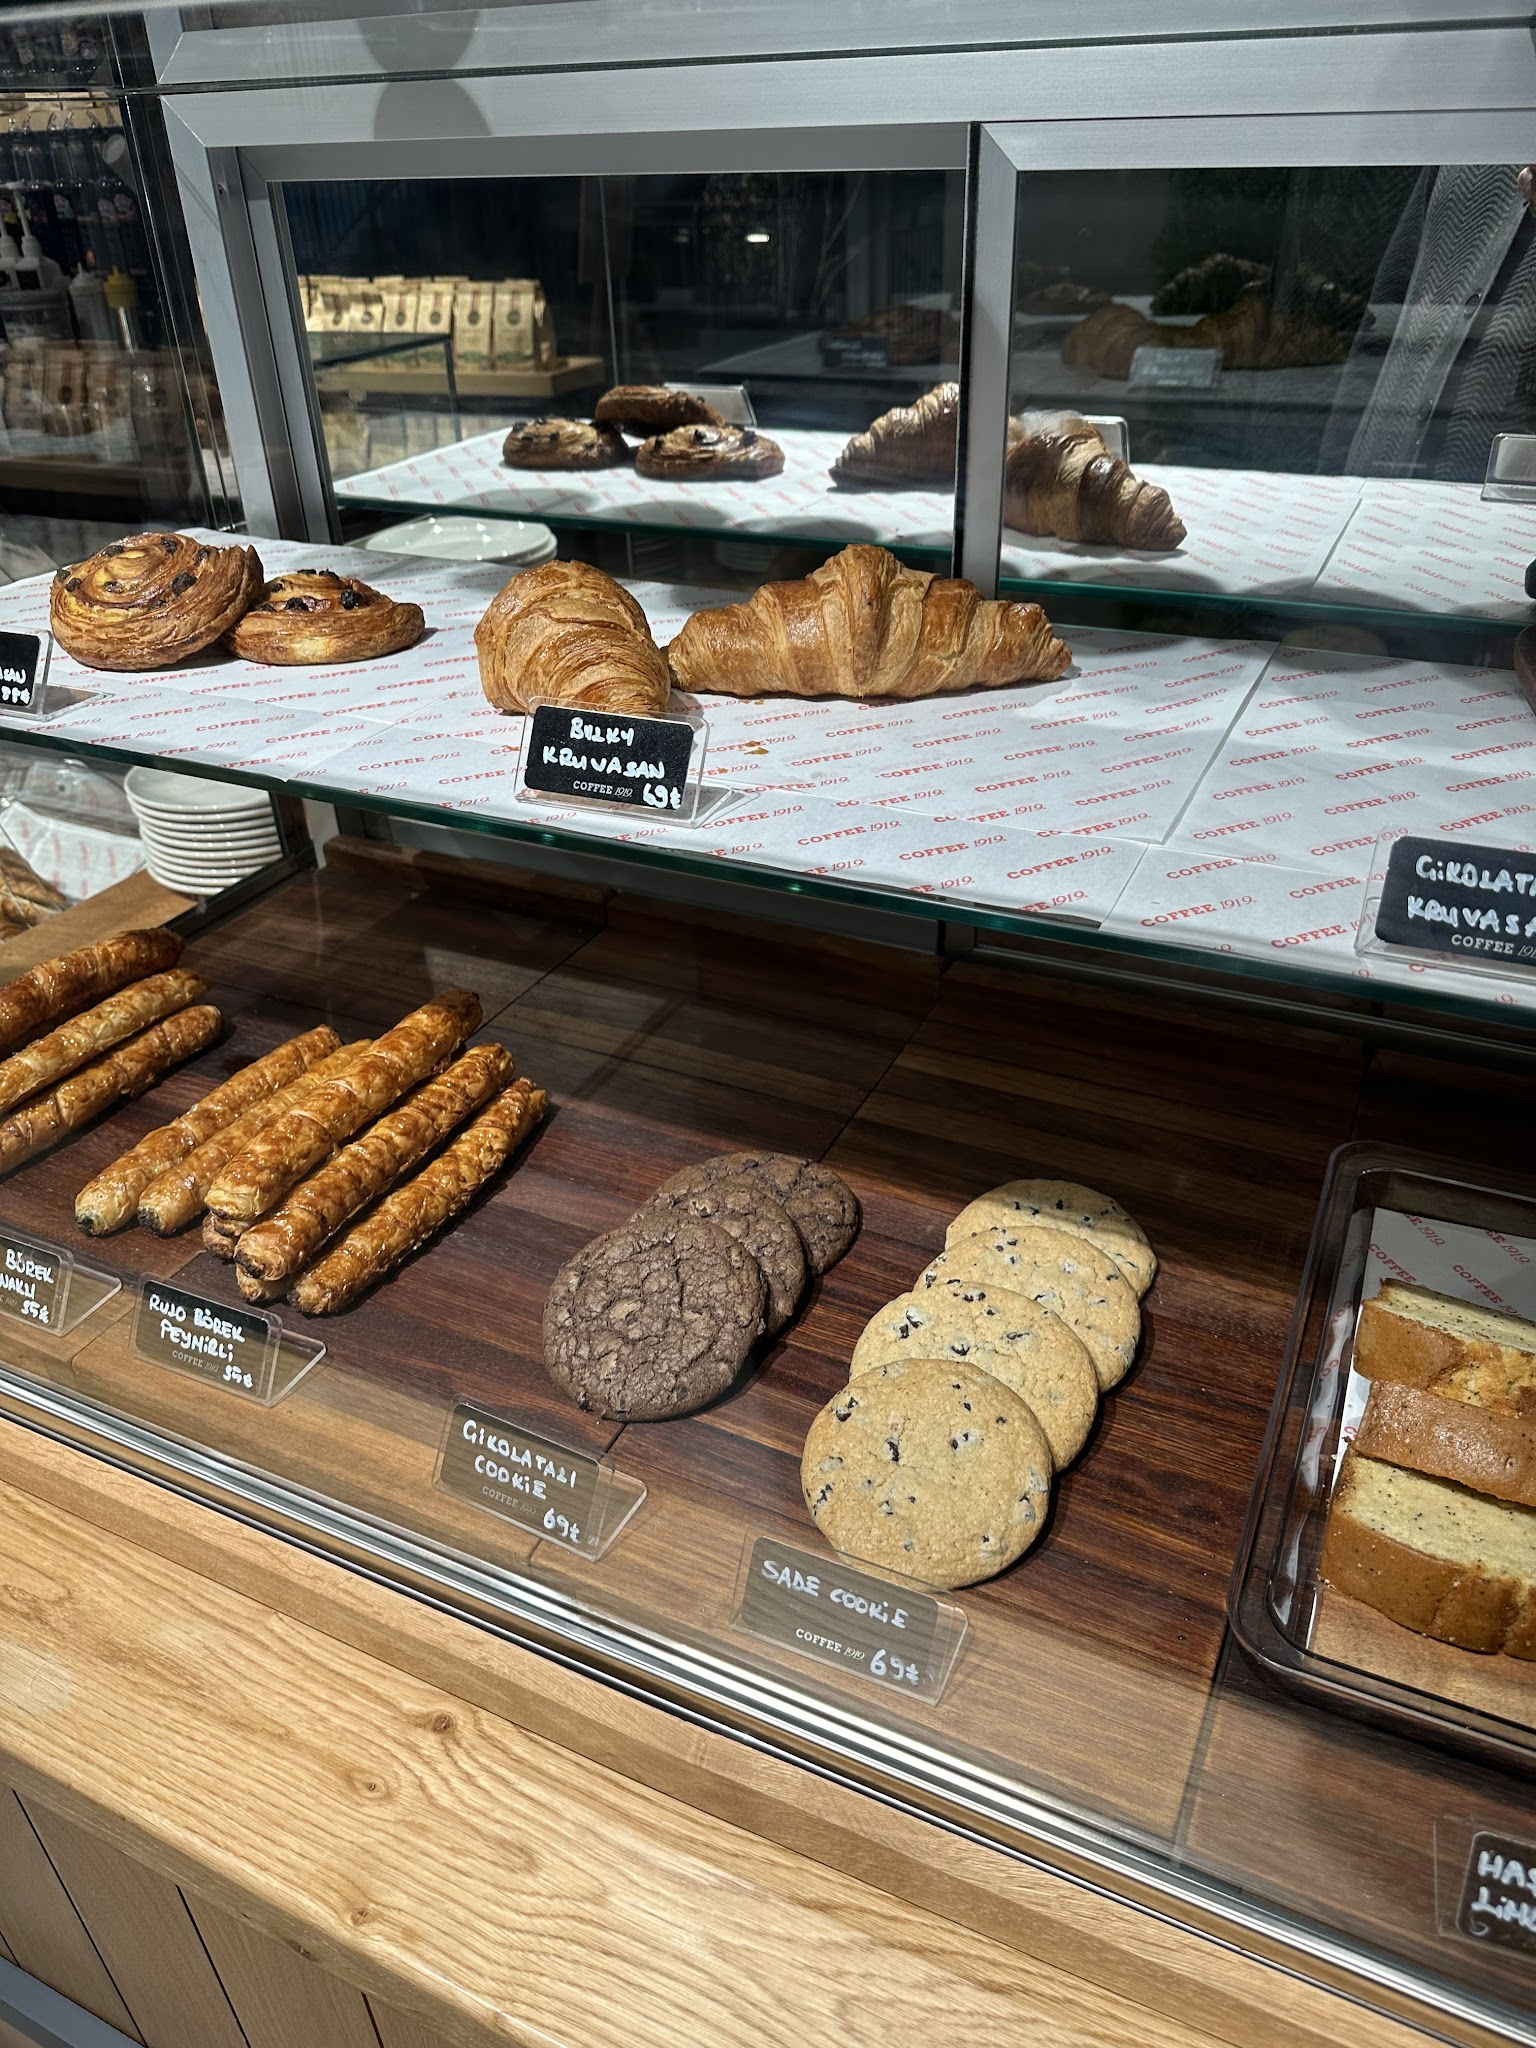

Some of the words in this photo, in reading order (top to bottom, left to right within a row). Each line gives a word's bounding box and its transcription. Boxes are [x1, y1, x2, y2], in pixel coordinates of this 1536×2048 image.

[1182, 647, 1233, 663] COFFEE
[1079, 665, 1130, 679] COFFEE
[1164, 671, 1218, 688] COFFEE
[1271, 670, 1323, 682] COFFEE
[376, 677, 435, 691] COFFEE
[1363, 680, 1416, 693] COFFEE
[254, 692, 317, 705] COFFEE
[1055, 689, 1111, 704] COFFEE
[1259, 695, 1313, 709] COFFEE
[1459, 690, 1512, 704] COFFEE
[322, 702, 386, 717] COFFEE
[942, 706, 999, 720] COFFEE
[1145, 697, 1201, 714] COFFEE
[1355, 705, 1409, 719] COFFEE
[129, 707, 194, 721] COFFEE
[743, 713, 801, 727] COFFEE
[196, 718, 260, 732] COFFEE
[825, 723, 884, 738] COFFEE
[1030, 716, 1088, 730] COFFEE
[1245, 723, 1301, 738] COFFEE
[1455, 716, 1510, 731] COFFEE
[265, 729, 330, 744] COFFEE
[912, 733, 972, 749] COFFEE
[1124, 725, 1184, 742] COFFEE
[1346, 733, 1402, 748] COFFEE
[791, 752, 853, 767] COFFEE
[1003, 745, 1064, 761] COFFEE
[1229, 750, 1289, 767] COFFEE
[1451, 745, 1508, 761] COFFEE
[358, 756, 425, 771] COFFEE
[880, 763, 942, 779] COFFEE
[1101, 755, 1163, 774] COFFEE
[1335, 763, 1395, 780] COFFEE
[438, 769, 506, 785] COFFEE
[975, 776, 1039, 793] COFFEE
[1445, 776, 1505, 793] COFFEE
[573, 781, 614, 795] COFFEE
[1212, 783, 1276, 801] COFFEE
[1075, 788, 1141, 806] COFFEE
[1324, 798, 1387, 816] COFFEE
[700, 812, 770, 829] COFFEE
[1440, 811, 1503, 832] COFFEE
[797, 826, 867, 846] COFFEE
[1193, 821, 1260, 840] COFFEE
[899, 842, 969, 861] COFFEE
[1310, 836, 1377, 856] COFFEE
[1006, 856, 1079, 879] COFFEE
[1166, 858, 1237, 880] COFFEE
[1288, 877, 1361, 899] COFFEE
[1140, 902, 1216, 928] COFFEE
[1271, 924, 1347, 949] COFFEE
[1451, 934, 1515, 954] COFFEE
[1369, 1243, 1416, 1283] COFFEE
[1452, 1264, 1503, 1305] COFFEE
[172, 1349, 203, 1368] COFFEE
[482, 1485, 518, 1509] COFFEE
[761, 1560, 821, 1597] SADE
[795, 1628, 842, 1653] COFFEE
